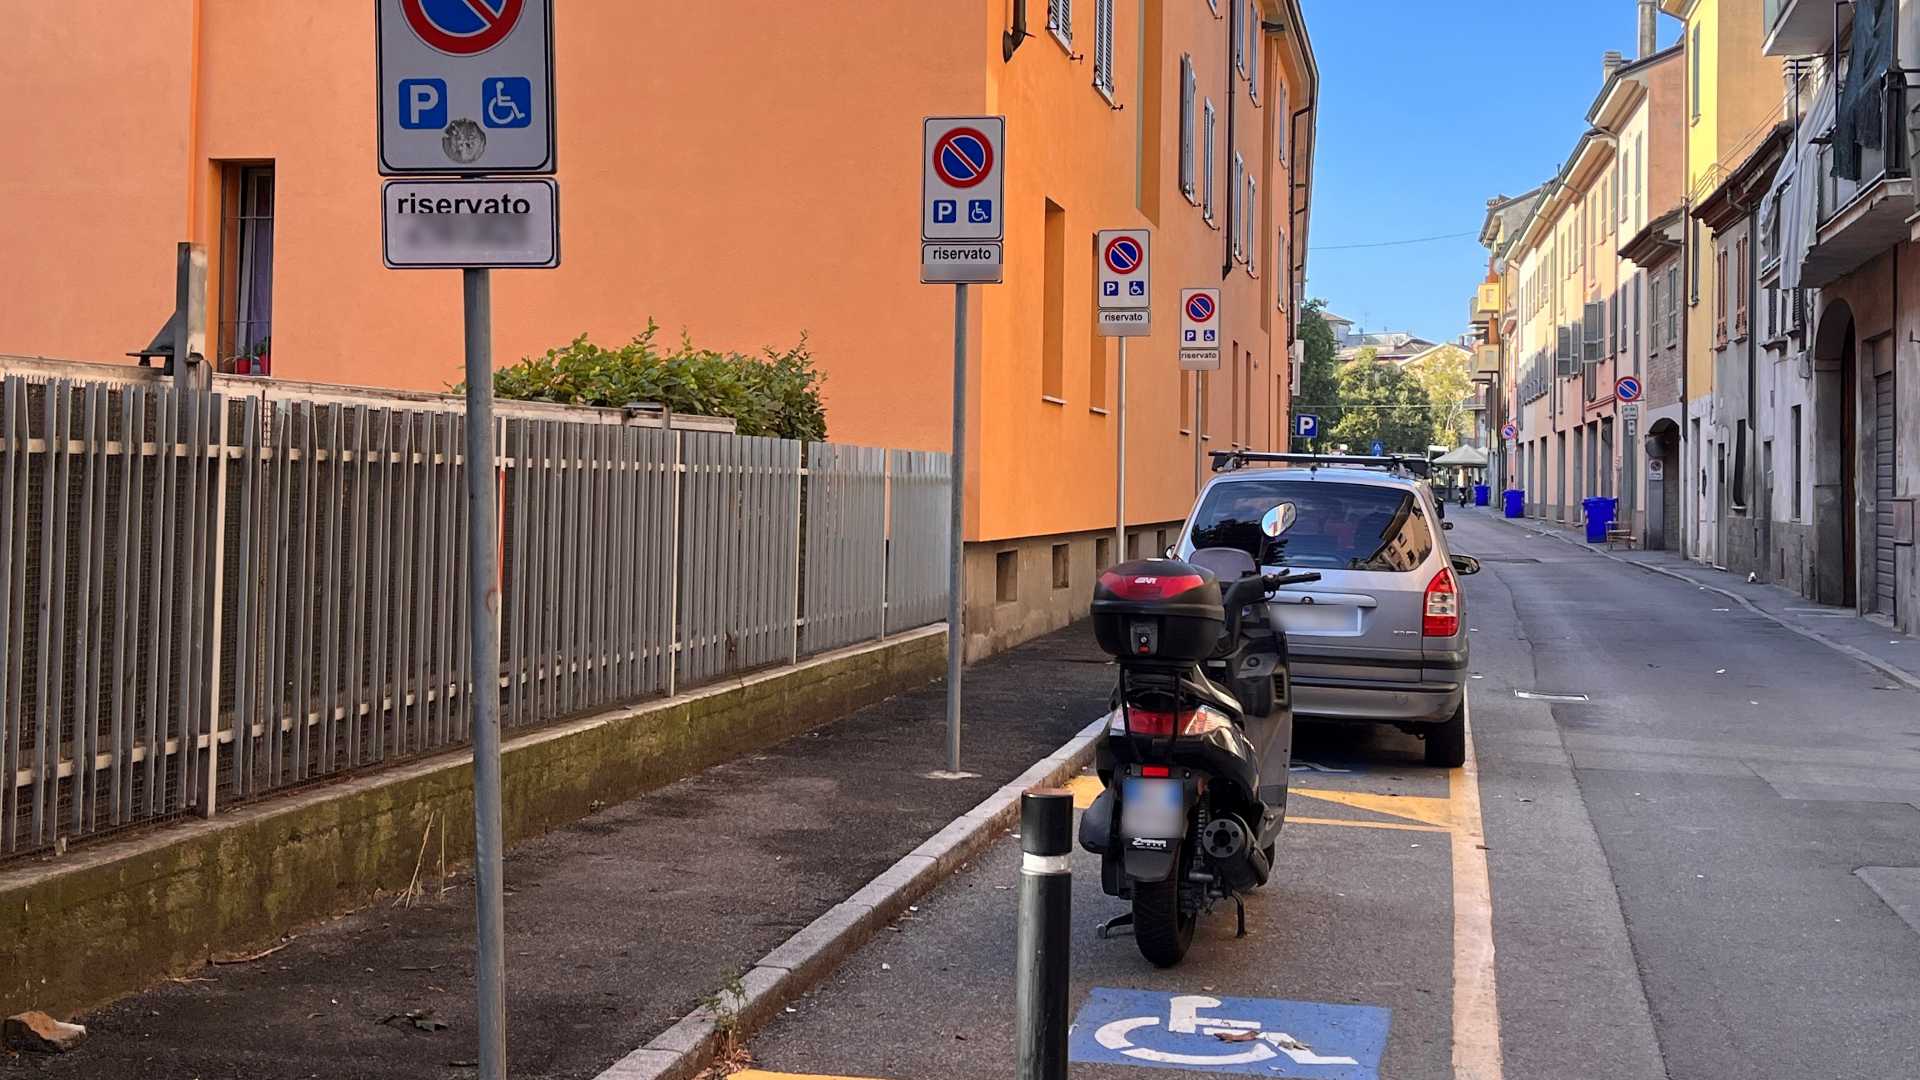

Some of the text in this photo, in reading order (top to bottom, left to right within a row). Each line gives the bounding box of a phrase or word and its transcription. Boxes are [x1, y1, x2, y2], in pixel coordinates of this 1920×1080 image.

[409, 84, 439, 124] P
[397, 193, 531, 214] riservato
[938, 202, 953, 221] P
[933, 246, 992, 260] riservato
[1106, 283, 1116, 295] P
[1104, 312, 1143, 321] riservato
[1186, 331, 1194, 341] P
[1300, 416, 1314, 435] P
